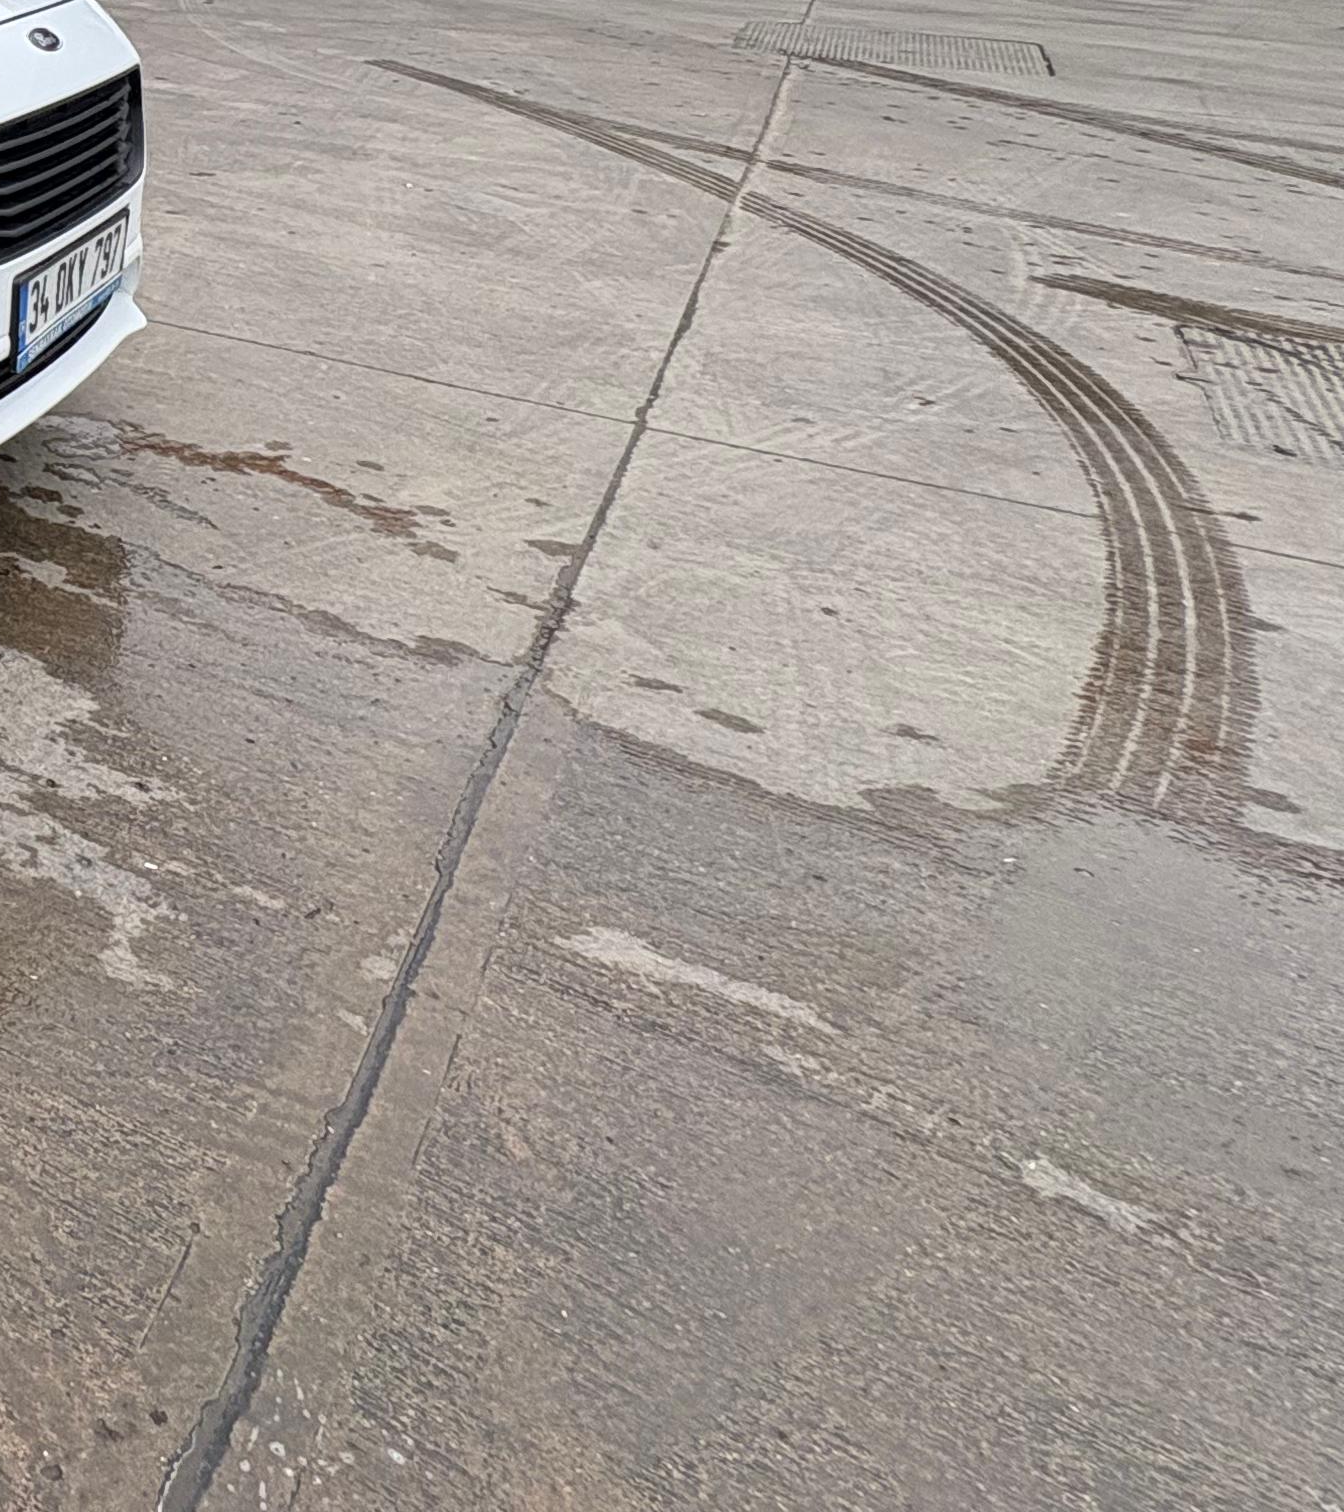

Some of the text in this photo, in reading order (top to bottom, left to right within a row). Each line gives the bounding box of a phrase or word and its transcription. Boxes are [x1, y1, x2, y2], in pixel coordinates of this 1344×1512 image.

[29, 223, 122, 333] 34 DKY 797
